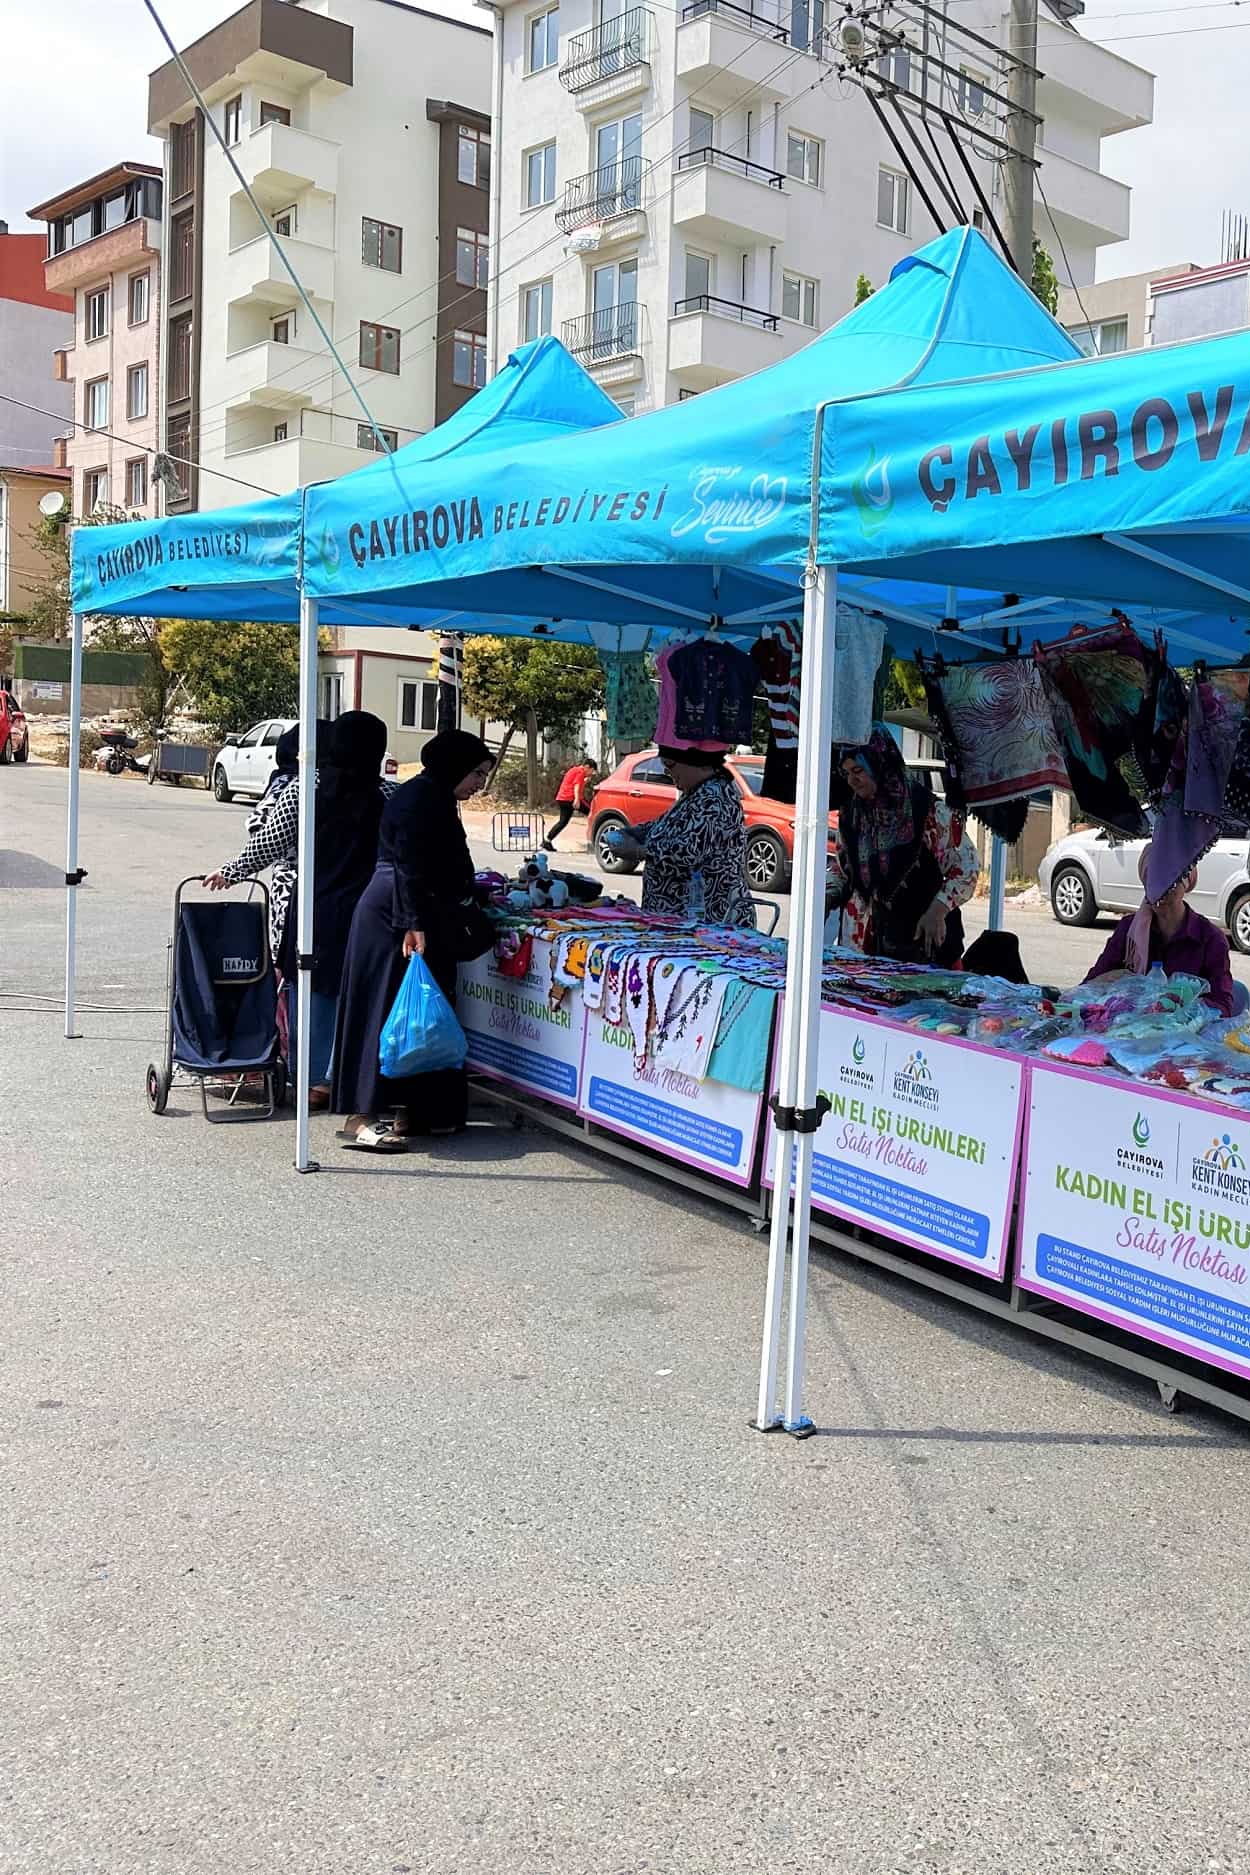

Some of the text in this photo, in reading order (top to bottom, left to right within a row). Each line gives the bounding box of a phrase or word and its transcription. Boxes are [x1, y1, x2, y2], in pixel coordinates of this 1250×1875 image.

[348, 496, 484, 569] ÇAYIROVA
[493, 483, 669, 535] BELEDİYESİ
[671, 473, 788, 544] Sevince
[97, 533, 164, 587] ÇAYIROVA
[602, 1024, 635, 1051] KADI
[893, 1077, 911, 1094] KENT
[849, 1099, 867, 1124] EL
[872, 1106, 892, 1136] İŞİ
[896, 1113, 986, 1165] ÜRÜNLERİ
[1116, 1147, 1164, 1171] ÇAYIROVA
[1055, 1164, 1127, 1209] KADIN
[1132, 1187, 1158, 1220] EL
[1163, 1199, 1192, 1234] İŞİ
[1191, 1182, 1220, 1198] KADIN
[1192, 1164, 1217, 1187] KENT
[1116, 1216, 1249, 1285] Satış Noktası
